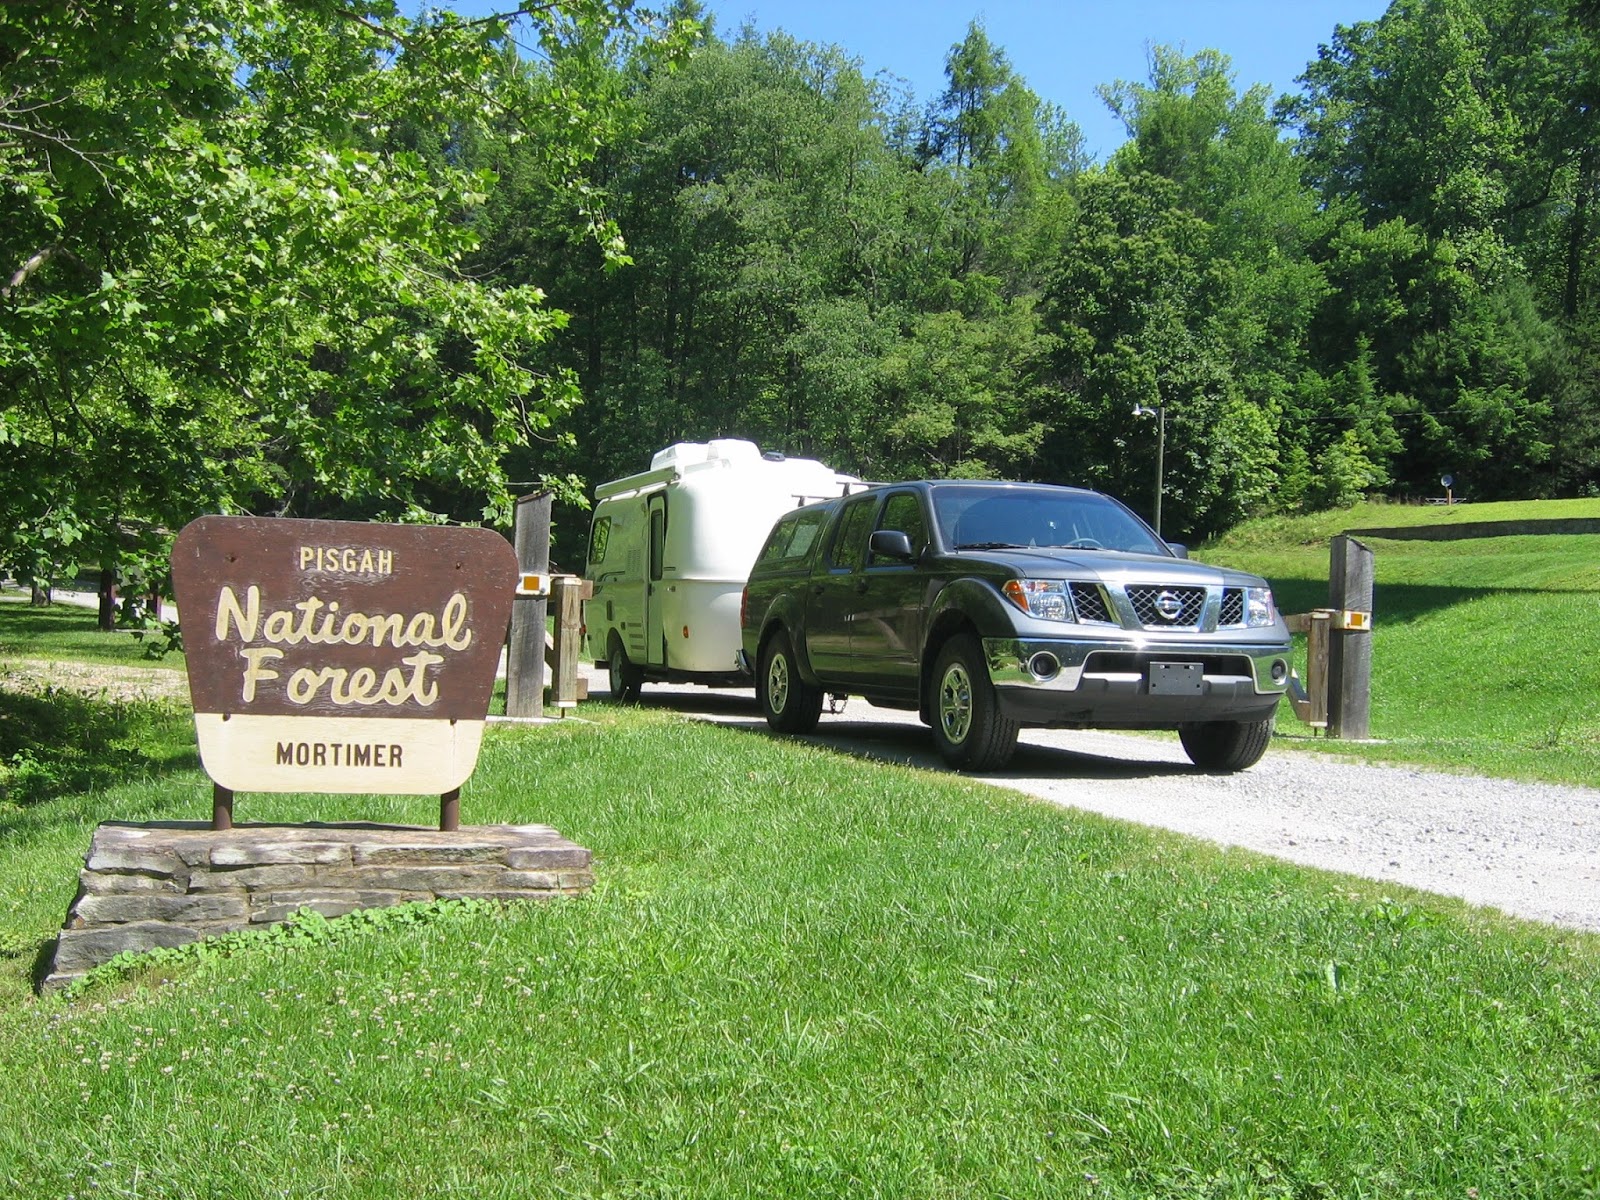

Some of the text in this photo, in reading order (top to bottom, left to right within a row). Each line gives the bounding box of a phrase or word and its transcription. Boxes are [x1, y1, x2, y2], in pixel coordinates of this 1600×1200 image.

[299, 546, 393, 574] PISGAH
[215, 585, 472, 651] National
[241, 647, 445, 706] Forest
[276, 742, 403, 768] MORTIMER
